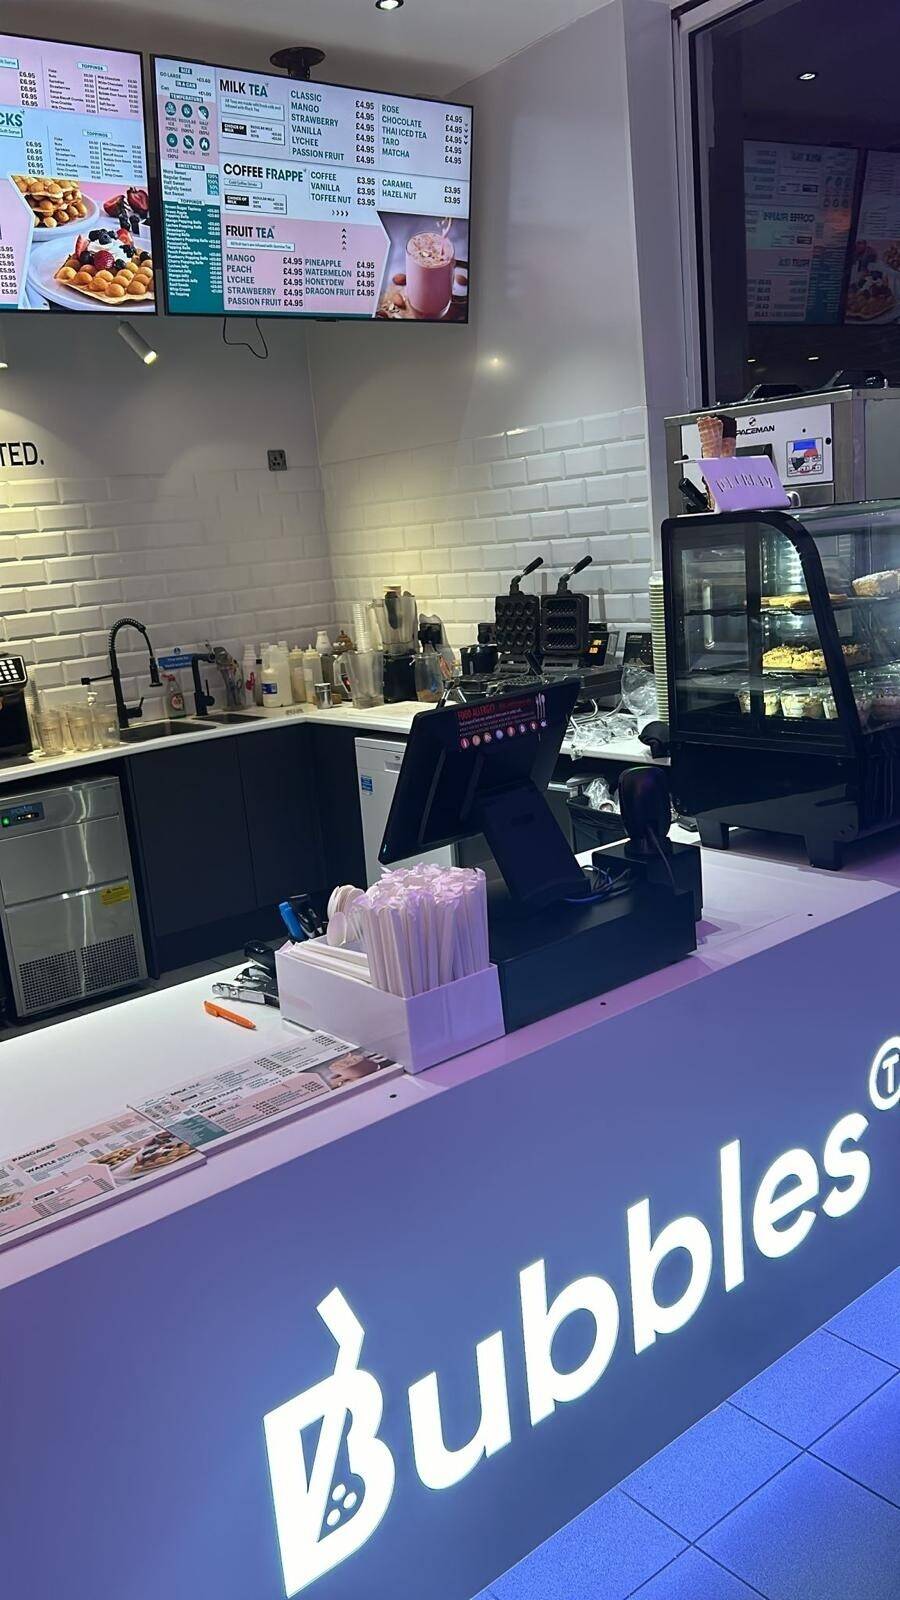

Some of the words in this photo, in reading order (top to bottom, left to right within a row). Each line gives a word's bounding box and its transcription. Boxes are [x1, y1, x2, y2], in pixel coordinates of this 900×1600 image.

[220, 79, 246, 94] MILK
[249, 84, 268, 97] TEA
[291, 90, 322, 102] CLASSIC
[291, 102, 320, 113] MANGO
[356, 101, 374, 110] £4.95
[382, 104, 400, 114] ROSE
[292, 114, 338, 127] STRAWBERRY
[356, 112, 374, 121] £4.95
[446, 115, 462, 123] £4.95
[382, 116, 422, 128] CHOCOLATE
[292, 125, 322, 136] VANILLA
[356, 123, 374, 132] £4.95
[446, 125, 462, 134] £4.95
[382, 127, 398, 136] THAI
[398, 129, 414, 138] ICED
[416, 132, 427, 140] TEA
[292, 136, 318, 147] LYCHEE
[356, 134, 374, 143] £4.95
[382, 137, 400, 146] TARO
[446, 136, 462, 144] £4.95
[292, 148, 323, 159] PASSION
[325, 152, 344, 160] FRUIT
[356, 145, 374, 154] £4.95
[382, 148, 410, 158] MATCHA
[445, 146, 462, 154] £4.95
[356, 156, 374, 164] £4.95
[445, 156, 462, 164] £4.95
[223, 163, 263, 178] COFFEE
[266, 168, 303, 182] FRAPPE
[311, 171, 336, 181] COFFEE
[357, 177, 375, 185] £3.95
[382, 179, 412, 189] CARAMEL
[311, 182, 340, 192] VANILLA
[444, 186, 460, 194] £3.95
[357, 188, 375, 196] £3.95
[382, 189, 402, 198] HAZEL
[404, 192, 416, 200] NUT
[311, 193, 336, 202] TOFFEE
[338, 196, 351, 204] NUT
[357, 198, 375, 206] £3.95
[444, 196, 460, 204] £3.95
[226, 225, 253, 237] FRUIT
[256, 227, 274, 239] TEA
[227, 254, 255, 263] MANGO
[305, 259, 341, 268] PINEAPPLE
[227, 265, 252, 273] PEACH
[283, 268, 302, 276] £4.95
[305, 268, 352, 277] WATERMELON
[284, 278, 302, 286] £4.95
[305, 278, 344, 286] HONEYDEW
[228, 286, 276, 296] STRAWBERRY
[284, 288, 303, 296] £4.95
[306, 288, 334, 296] DRAGON
[228, 297, 260, 305] PASSION
[261, 298, 281, 306] FRUIT
[284, 299, 303, 307] £4.95
[736, 425, 775, 436] PACEMAN
[263, 1113, 871, 1598] Bubbles
